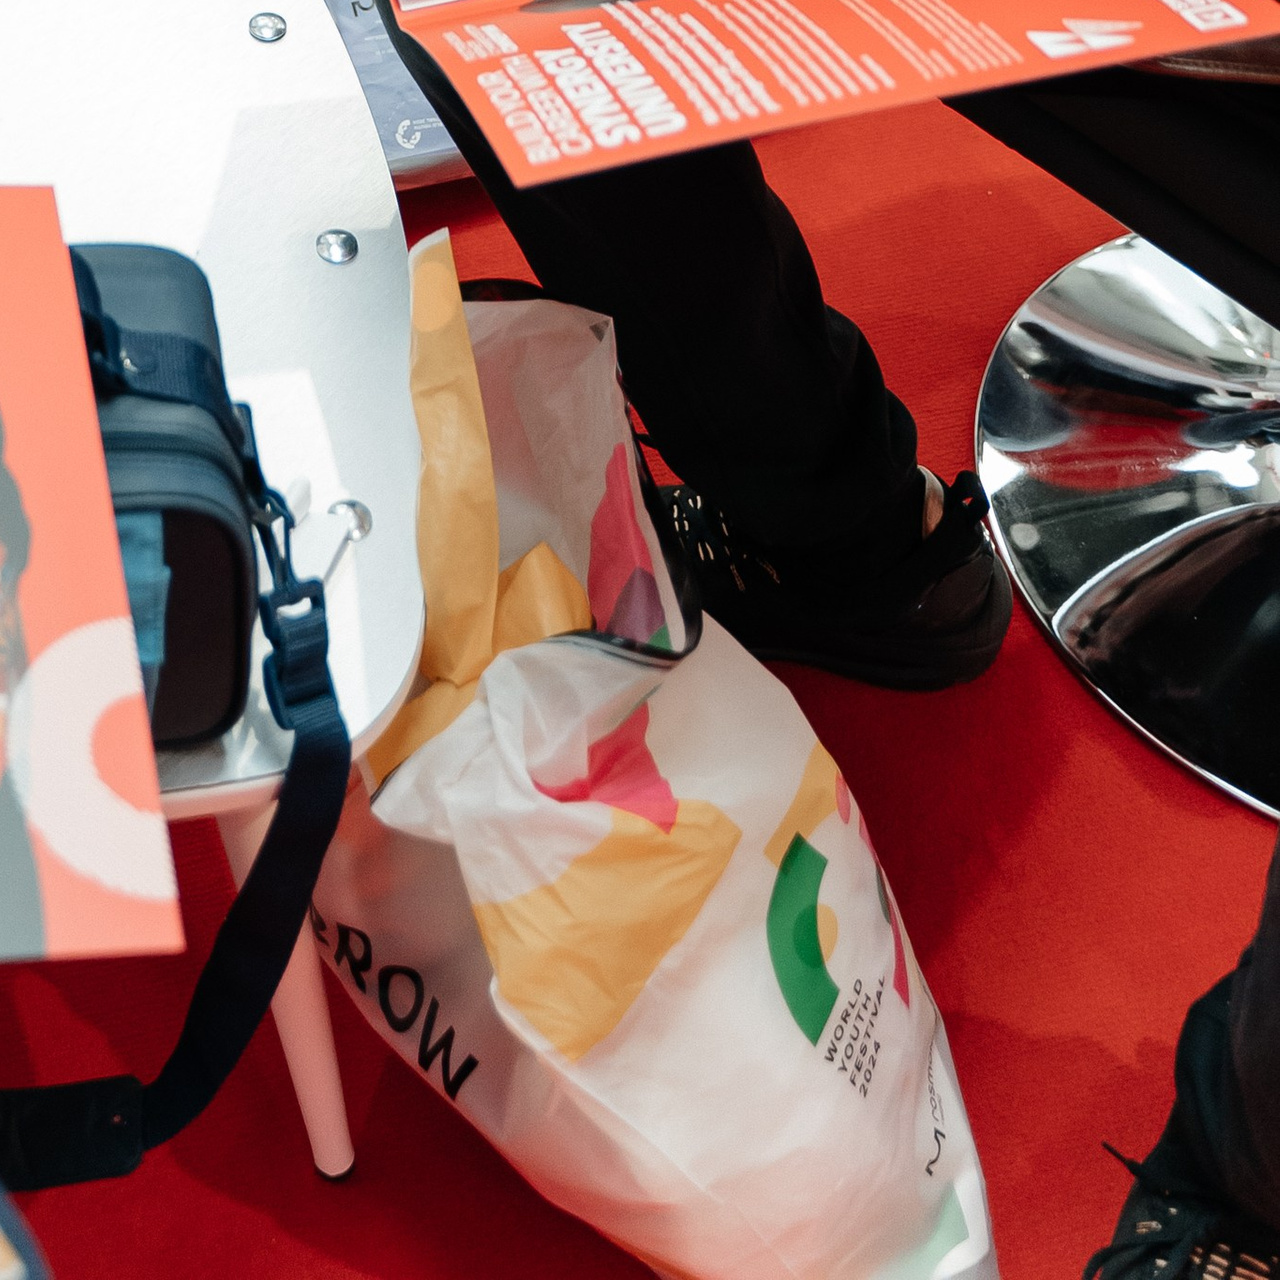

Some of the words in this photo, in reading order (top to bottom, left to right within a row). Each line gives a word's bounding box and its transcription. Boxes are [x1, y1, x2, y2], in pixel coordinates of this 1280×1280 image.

[533, 47, 642, 149] SYNERGY
[560, 21, 688, 138] UNIVERSITY
[824, 978, 863, 1063] WORLD
[837, 992, 873, 1074] YOUTH
[849, 975, 886, 1088] FESTIVAL
[858, 1040, 882, 1098] 2024
